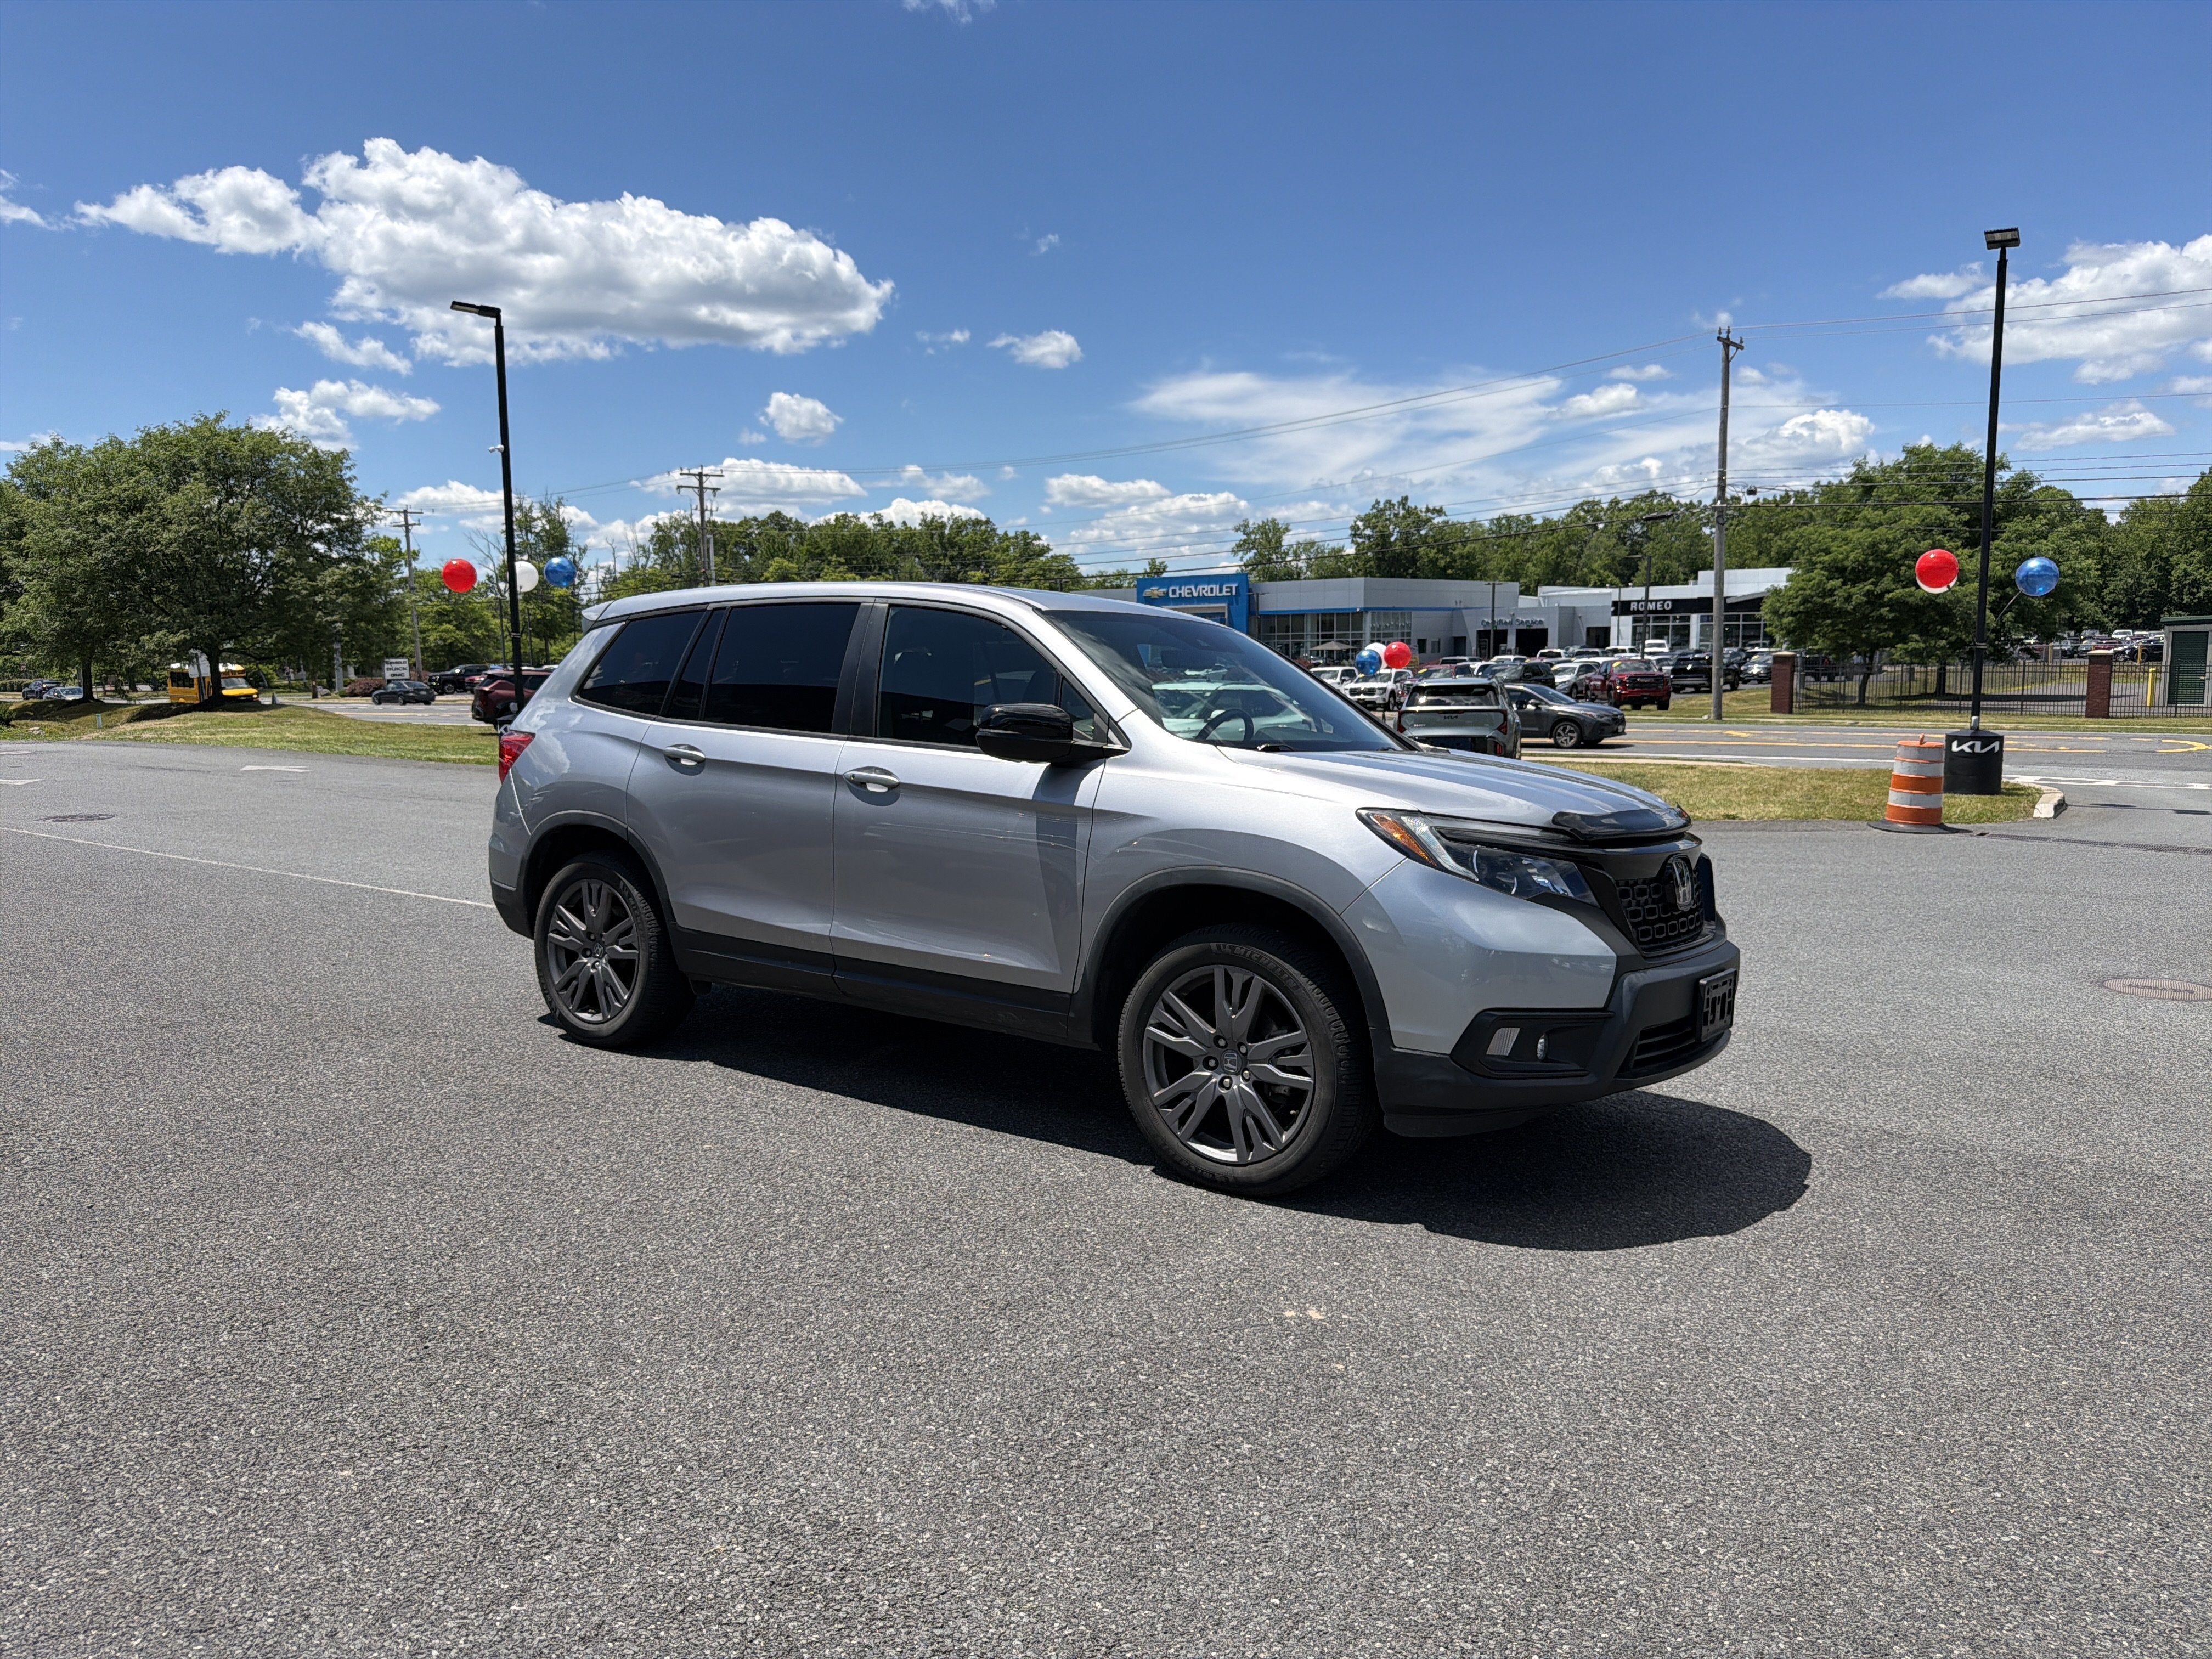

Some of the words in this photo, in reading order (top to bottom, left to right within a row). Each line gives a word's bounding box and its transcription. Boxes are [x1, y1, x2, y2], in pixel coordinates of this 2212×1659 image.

[1169, 584, 1238, 598] CHEVROLET
[1630, 601, 1672, 611] ROMEO
[1951, 740, 2000, 753] KIA
[1234, 946, 1301, 995] MICHELIN
